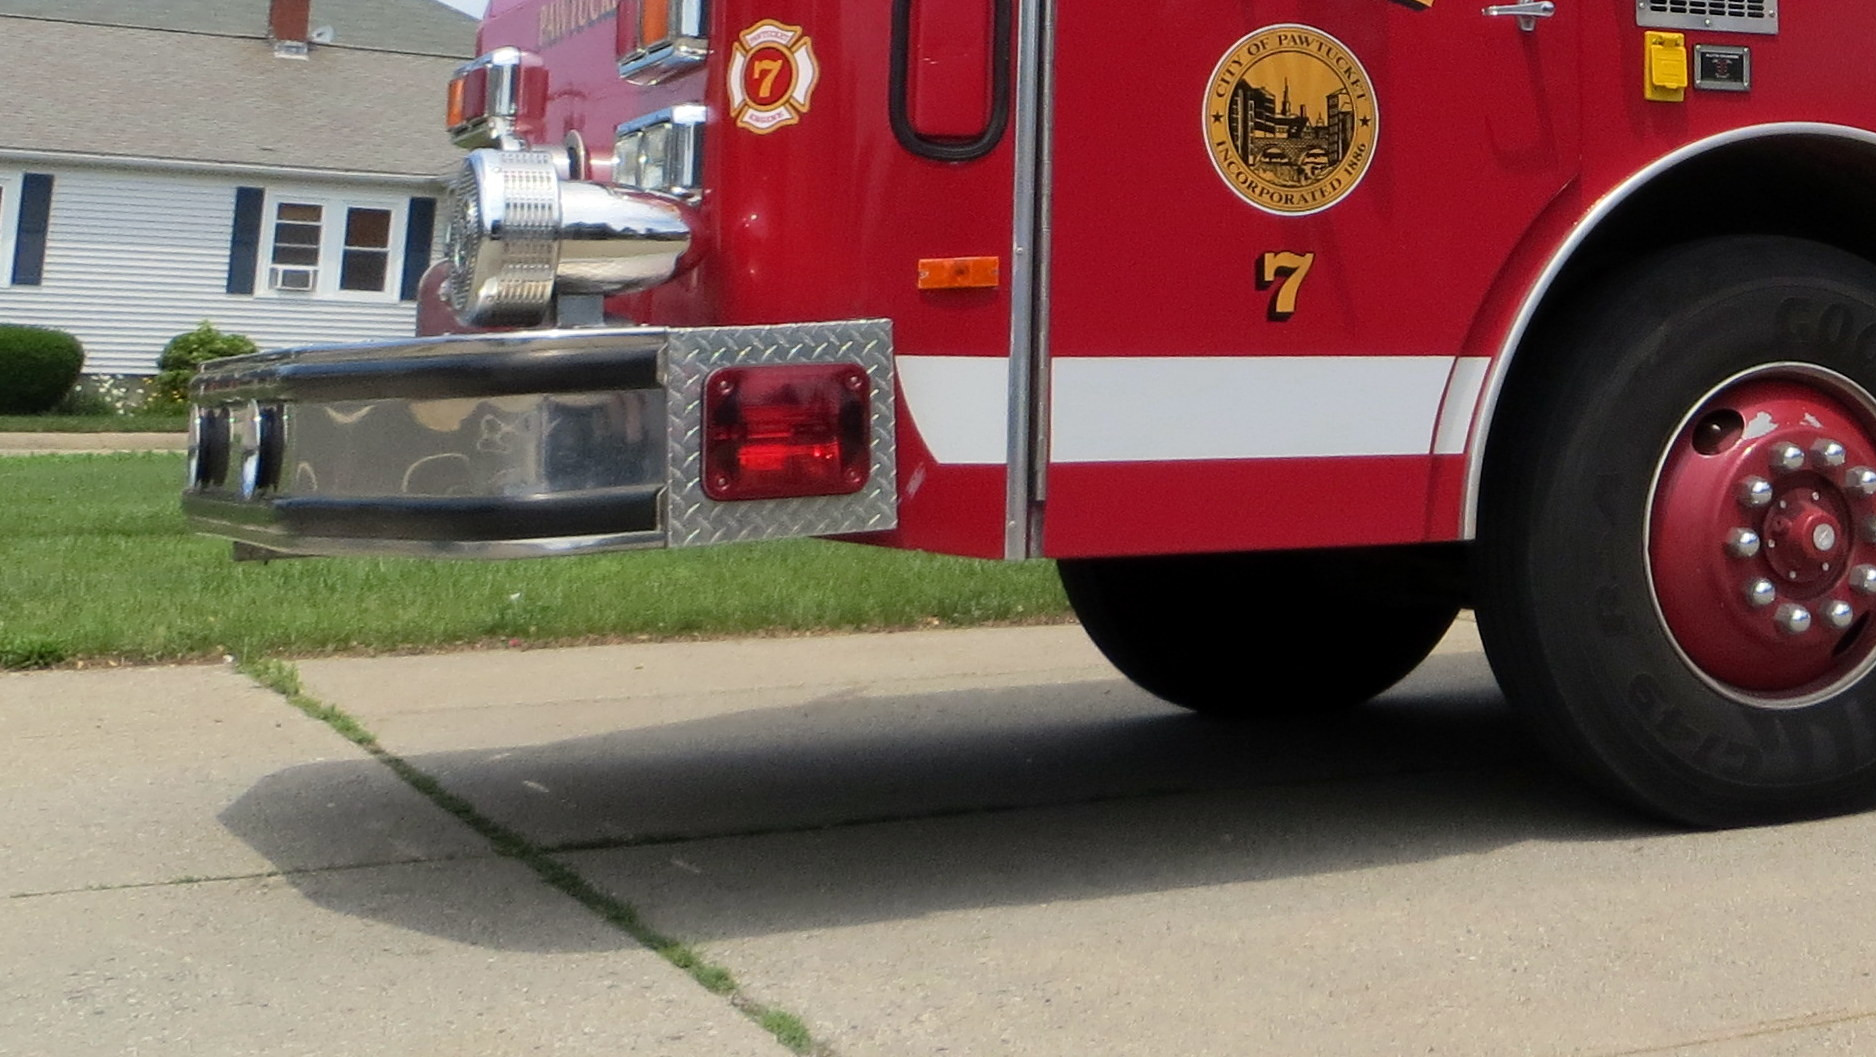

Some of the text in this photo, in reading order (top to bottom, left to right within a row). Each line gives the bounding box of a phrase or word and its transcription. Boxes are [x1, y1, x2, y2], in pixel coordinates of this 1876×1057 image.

[753, 59, 783, 97] 7
[1215, 33, 1368, 101] CITY OF PAWTUCKET
[1216, 140, 1368, 206] INCORPORATED 1886
[1255, 250, 1316, 322] 7
